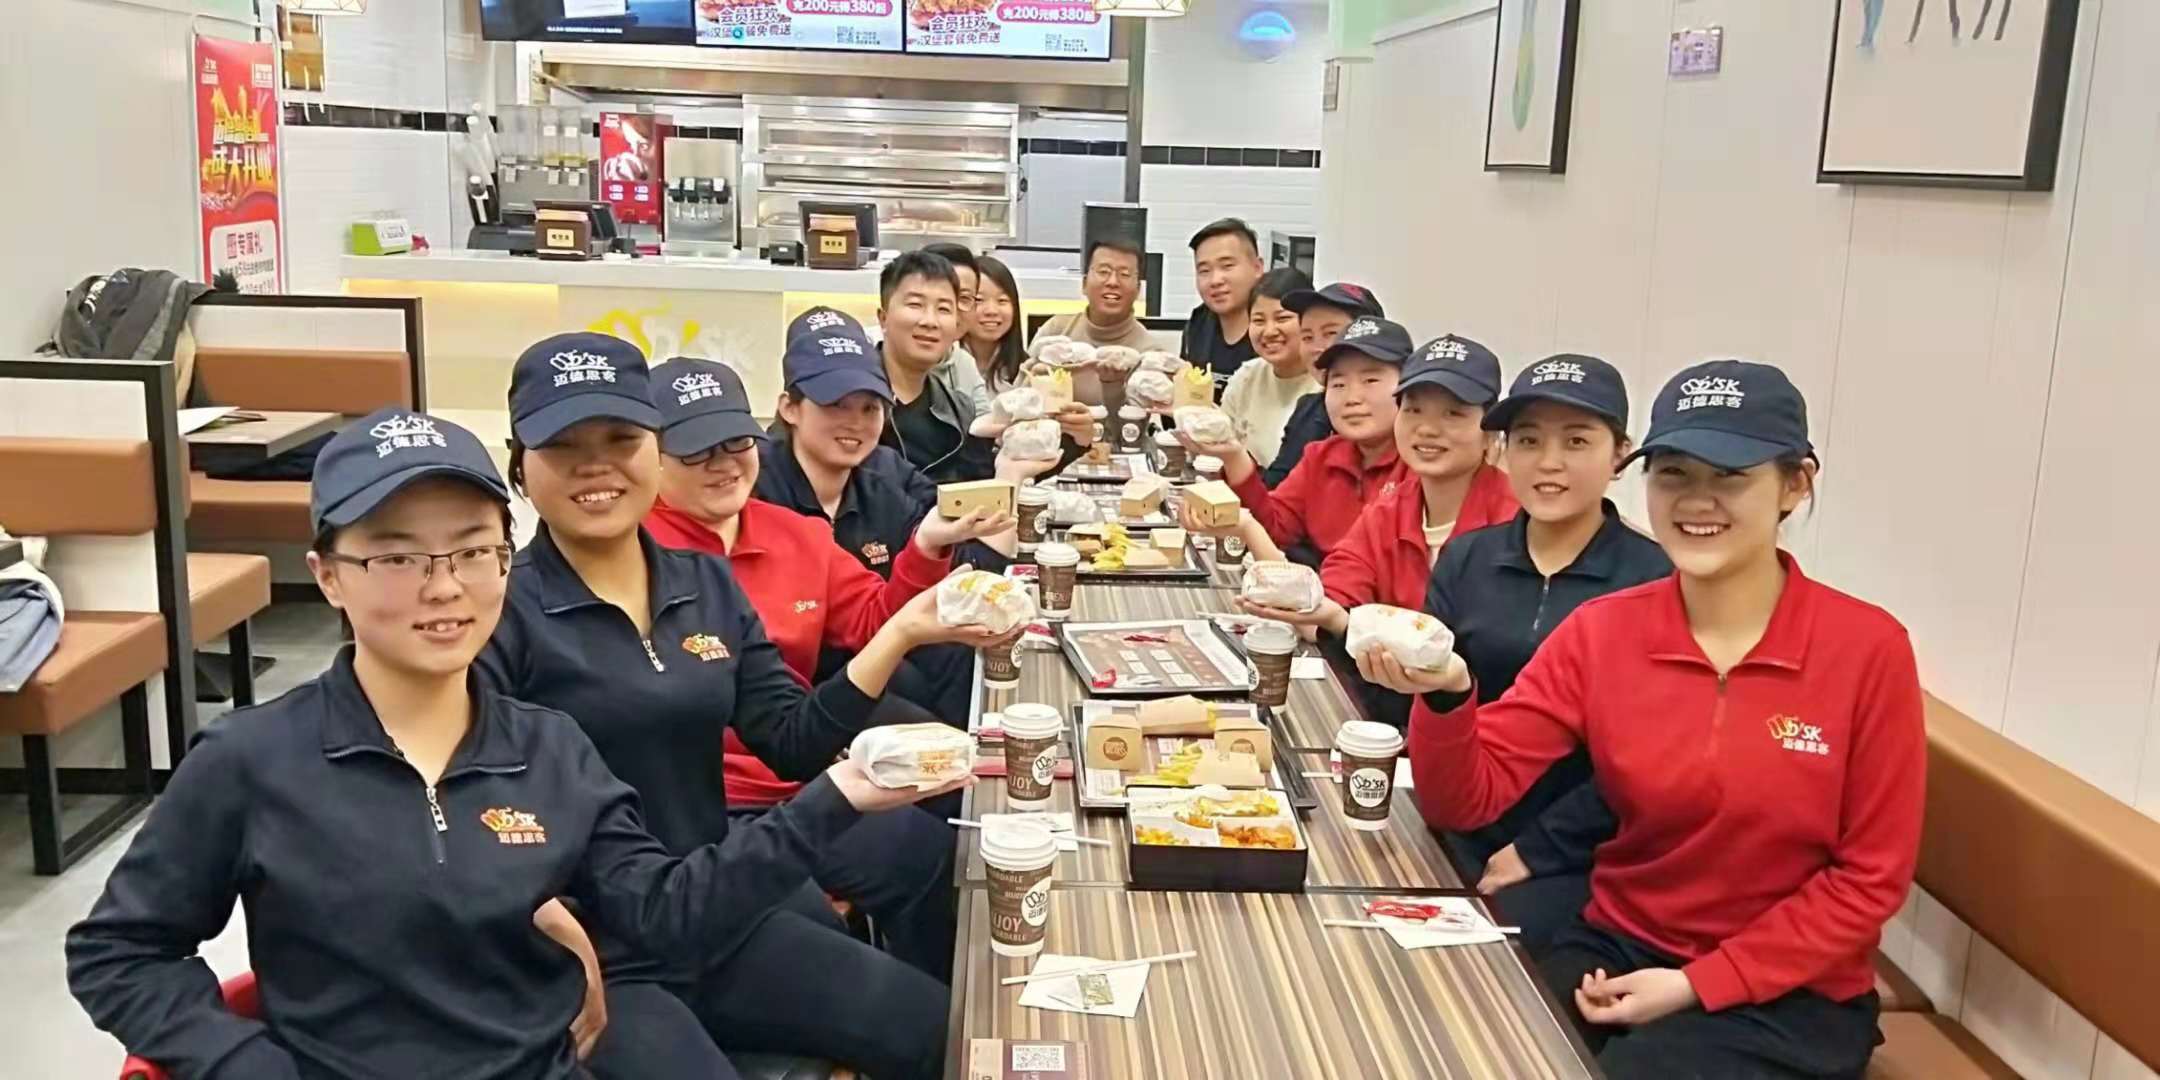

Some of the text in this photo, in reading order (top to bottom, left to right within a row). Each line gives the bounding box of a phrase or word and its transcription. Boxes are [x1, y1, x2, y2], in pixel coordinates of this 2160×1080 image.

[720, 8, 779, 24] 会员狂欢
[931, 15, 989, 30] 会员狂欢
[711, 24, 791, 39] 汉堡餐免费送
